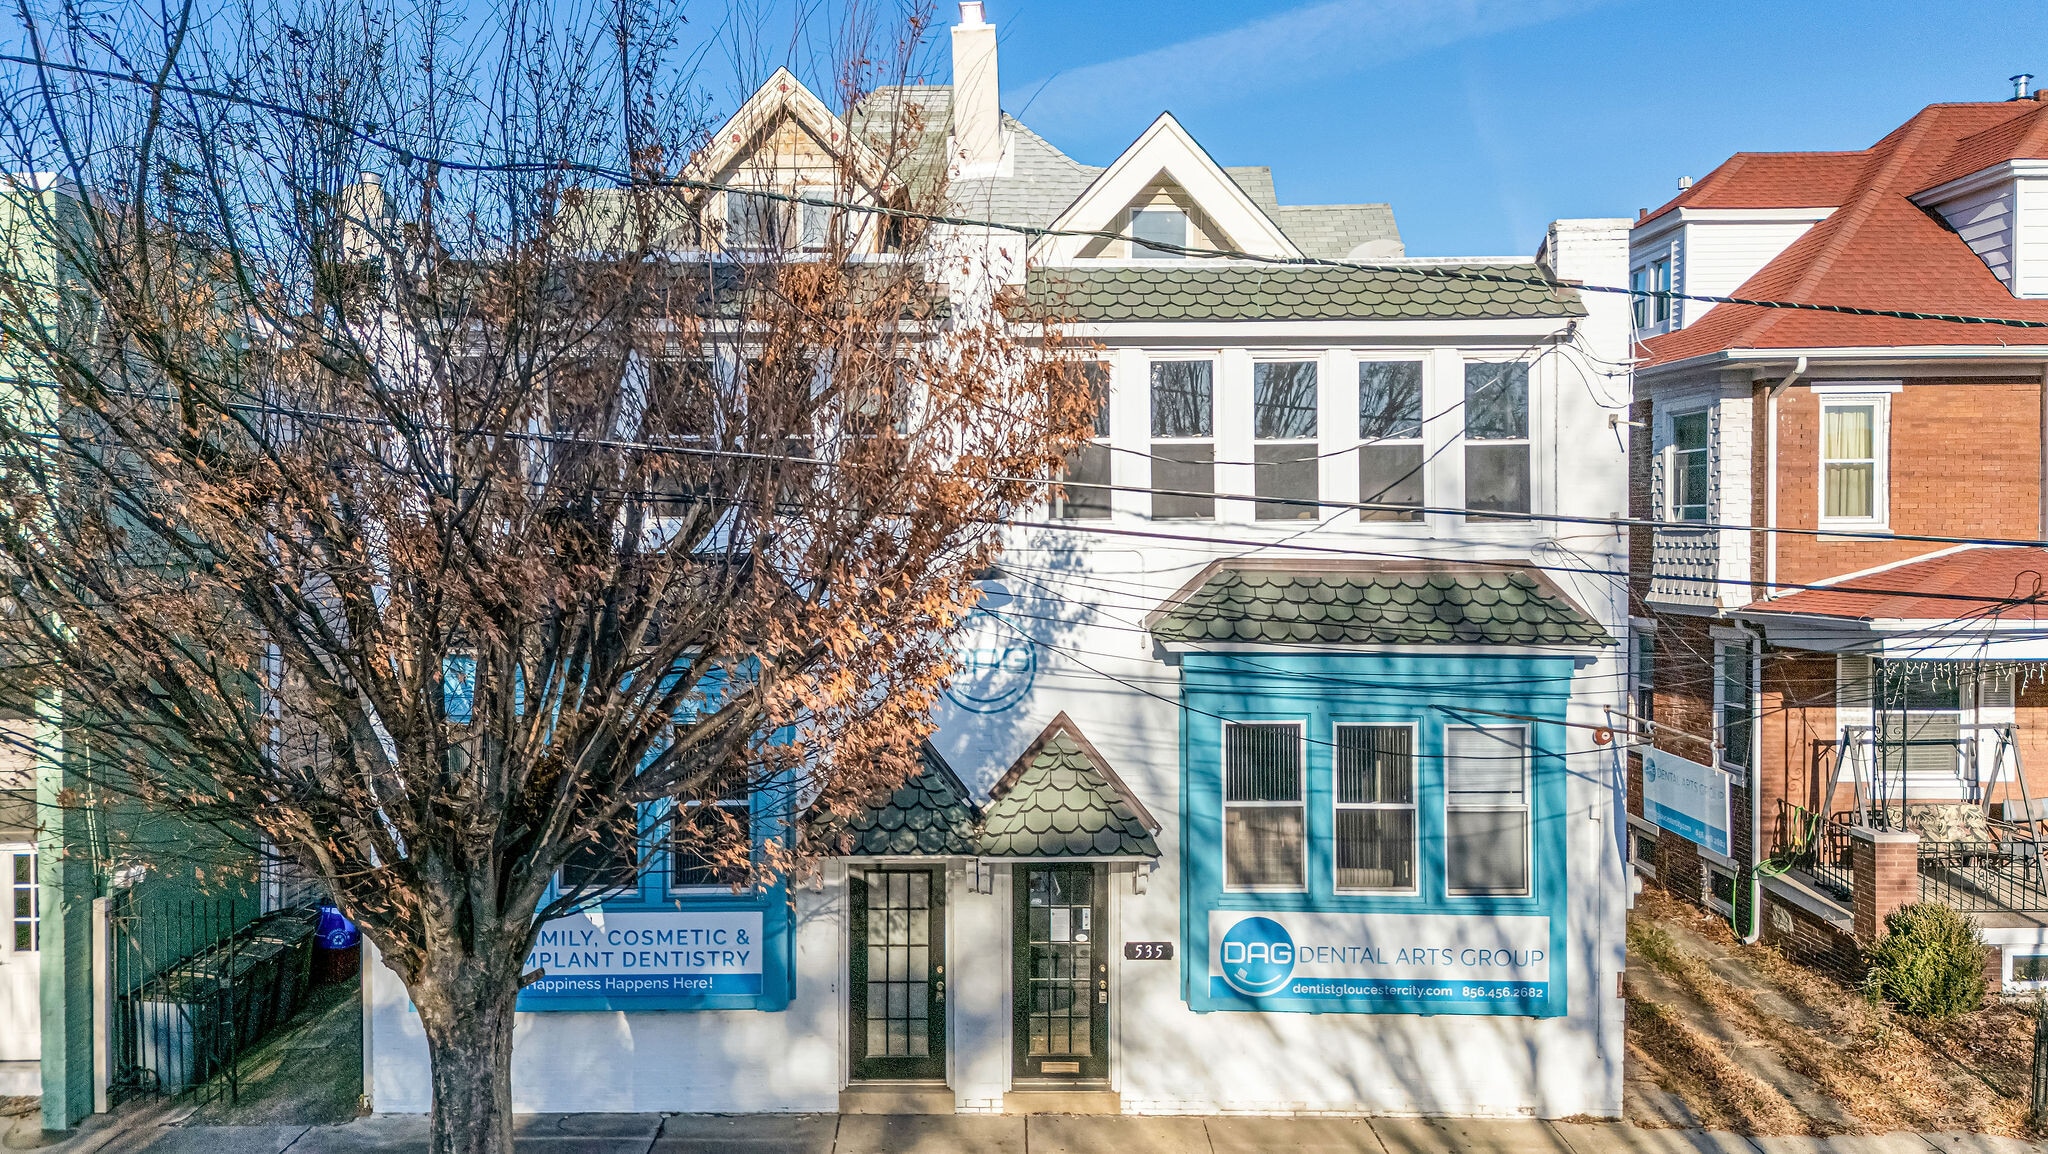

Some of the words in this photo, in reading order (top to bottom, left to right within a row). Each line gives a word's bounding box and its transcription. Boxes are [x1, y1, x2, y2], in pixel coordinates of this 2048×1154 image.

[534, 930, 598, 948] MILY,
[608, 929, 727, 946] COSMETIC
[736, 929, 750, 945] &
[525, 952, 614, 968] MPLANT
[623, 950, 750, 968] DENTISTRY
[1135, 944, 1163, 959] 535
[1224, 941, 1292, 964] DAG
[1300, 946, 1388, 965] DENTAL
[1395, 948, 1453, 966] ARTS
[1460, 948, 1544, 968] GROUP
[605, 977, 669, 992] Happens
[673, 976, 713, 989] Here!
[1292, 983, 1453, 998] dentistgloucestercity.com
[1462, 985, 1543, 998] 856.456.2682
